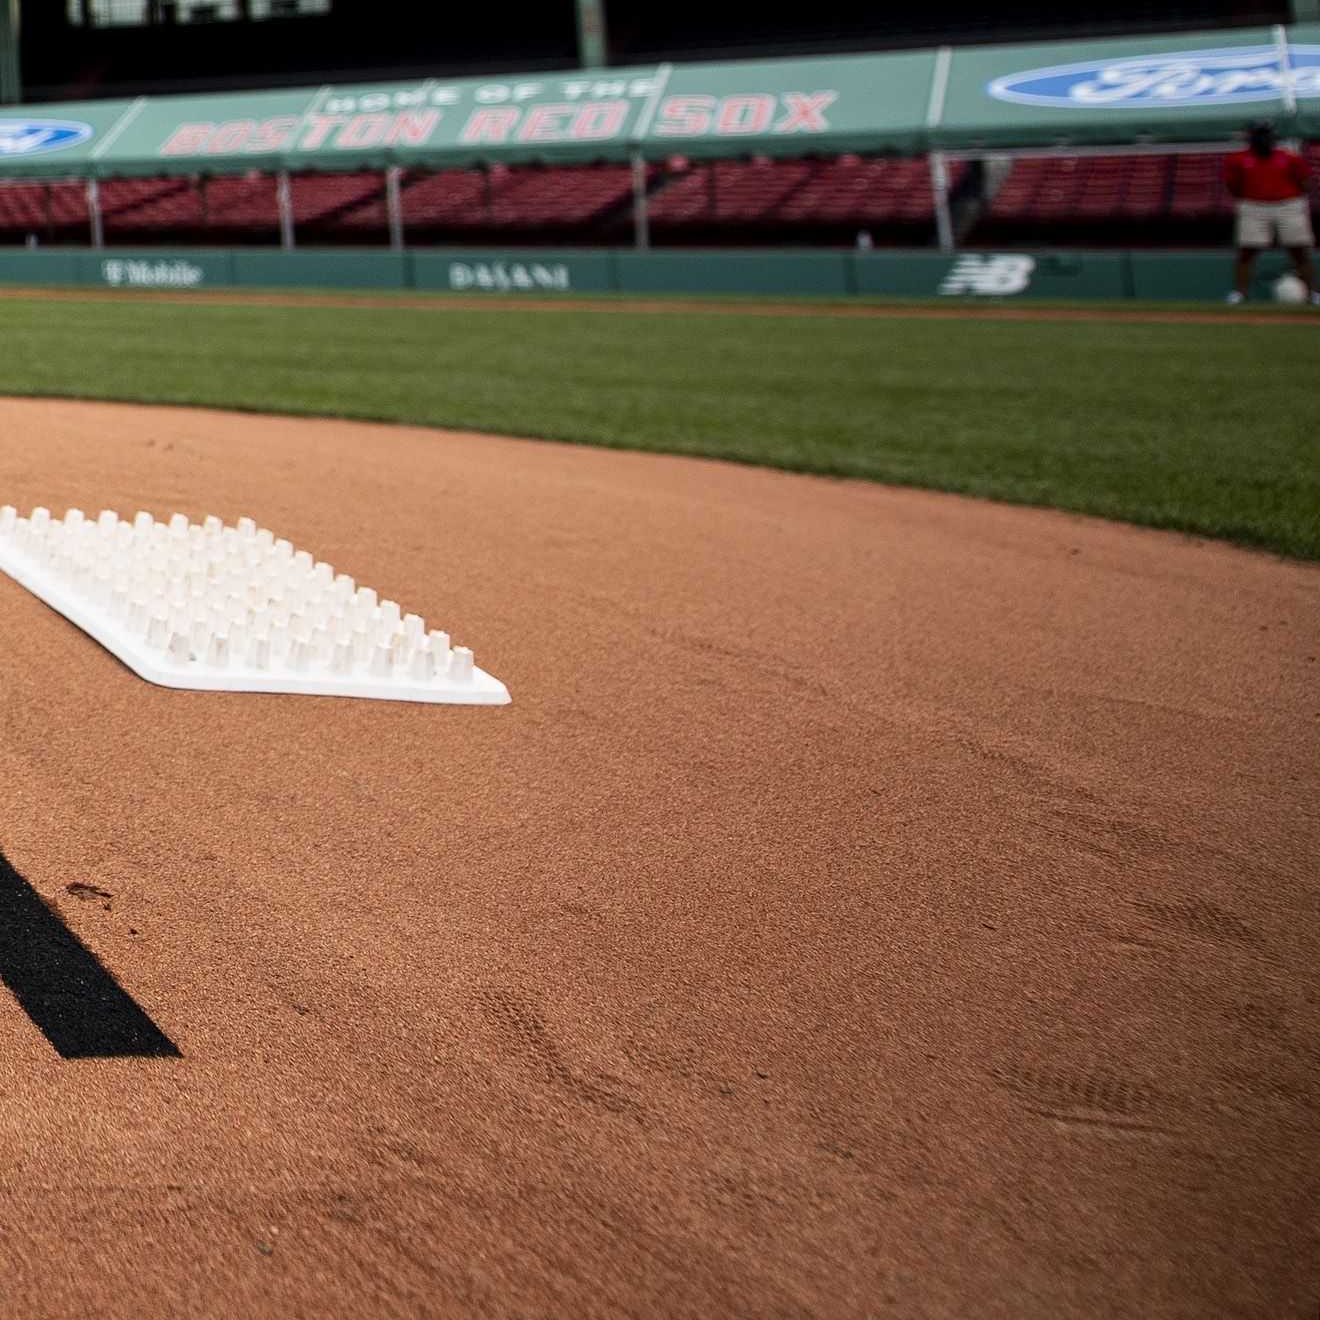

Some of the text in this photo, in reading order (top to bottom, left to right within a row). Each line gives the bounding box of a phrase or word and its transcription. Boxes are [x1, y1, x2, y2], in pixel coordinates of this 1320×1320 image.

[474, 82, 545, 104] OF
[561, 78, 662, 99] THE
[159, 88, 840, 157] BOSTON RED SOX
